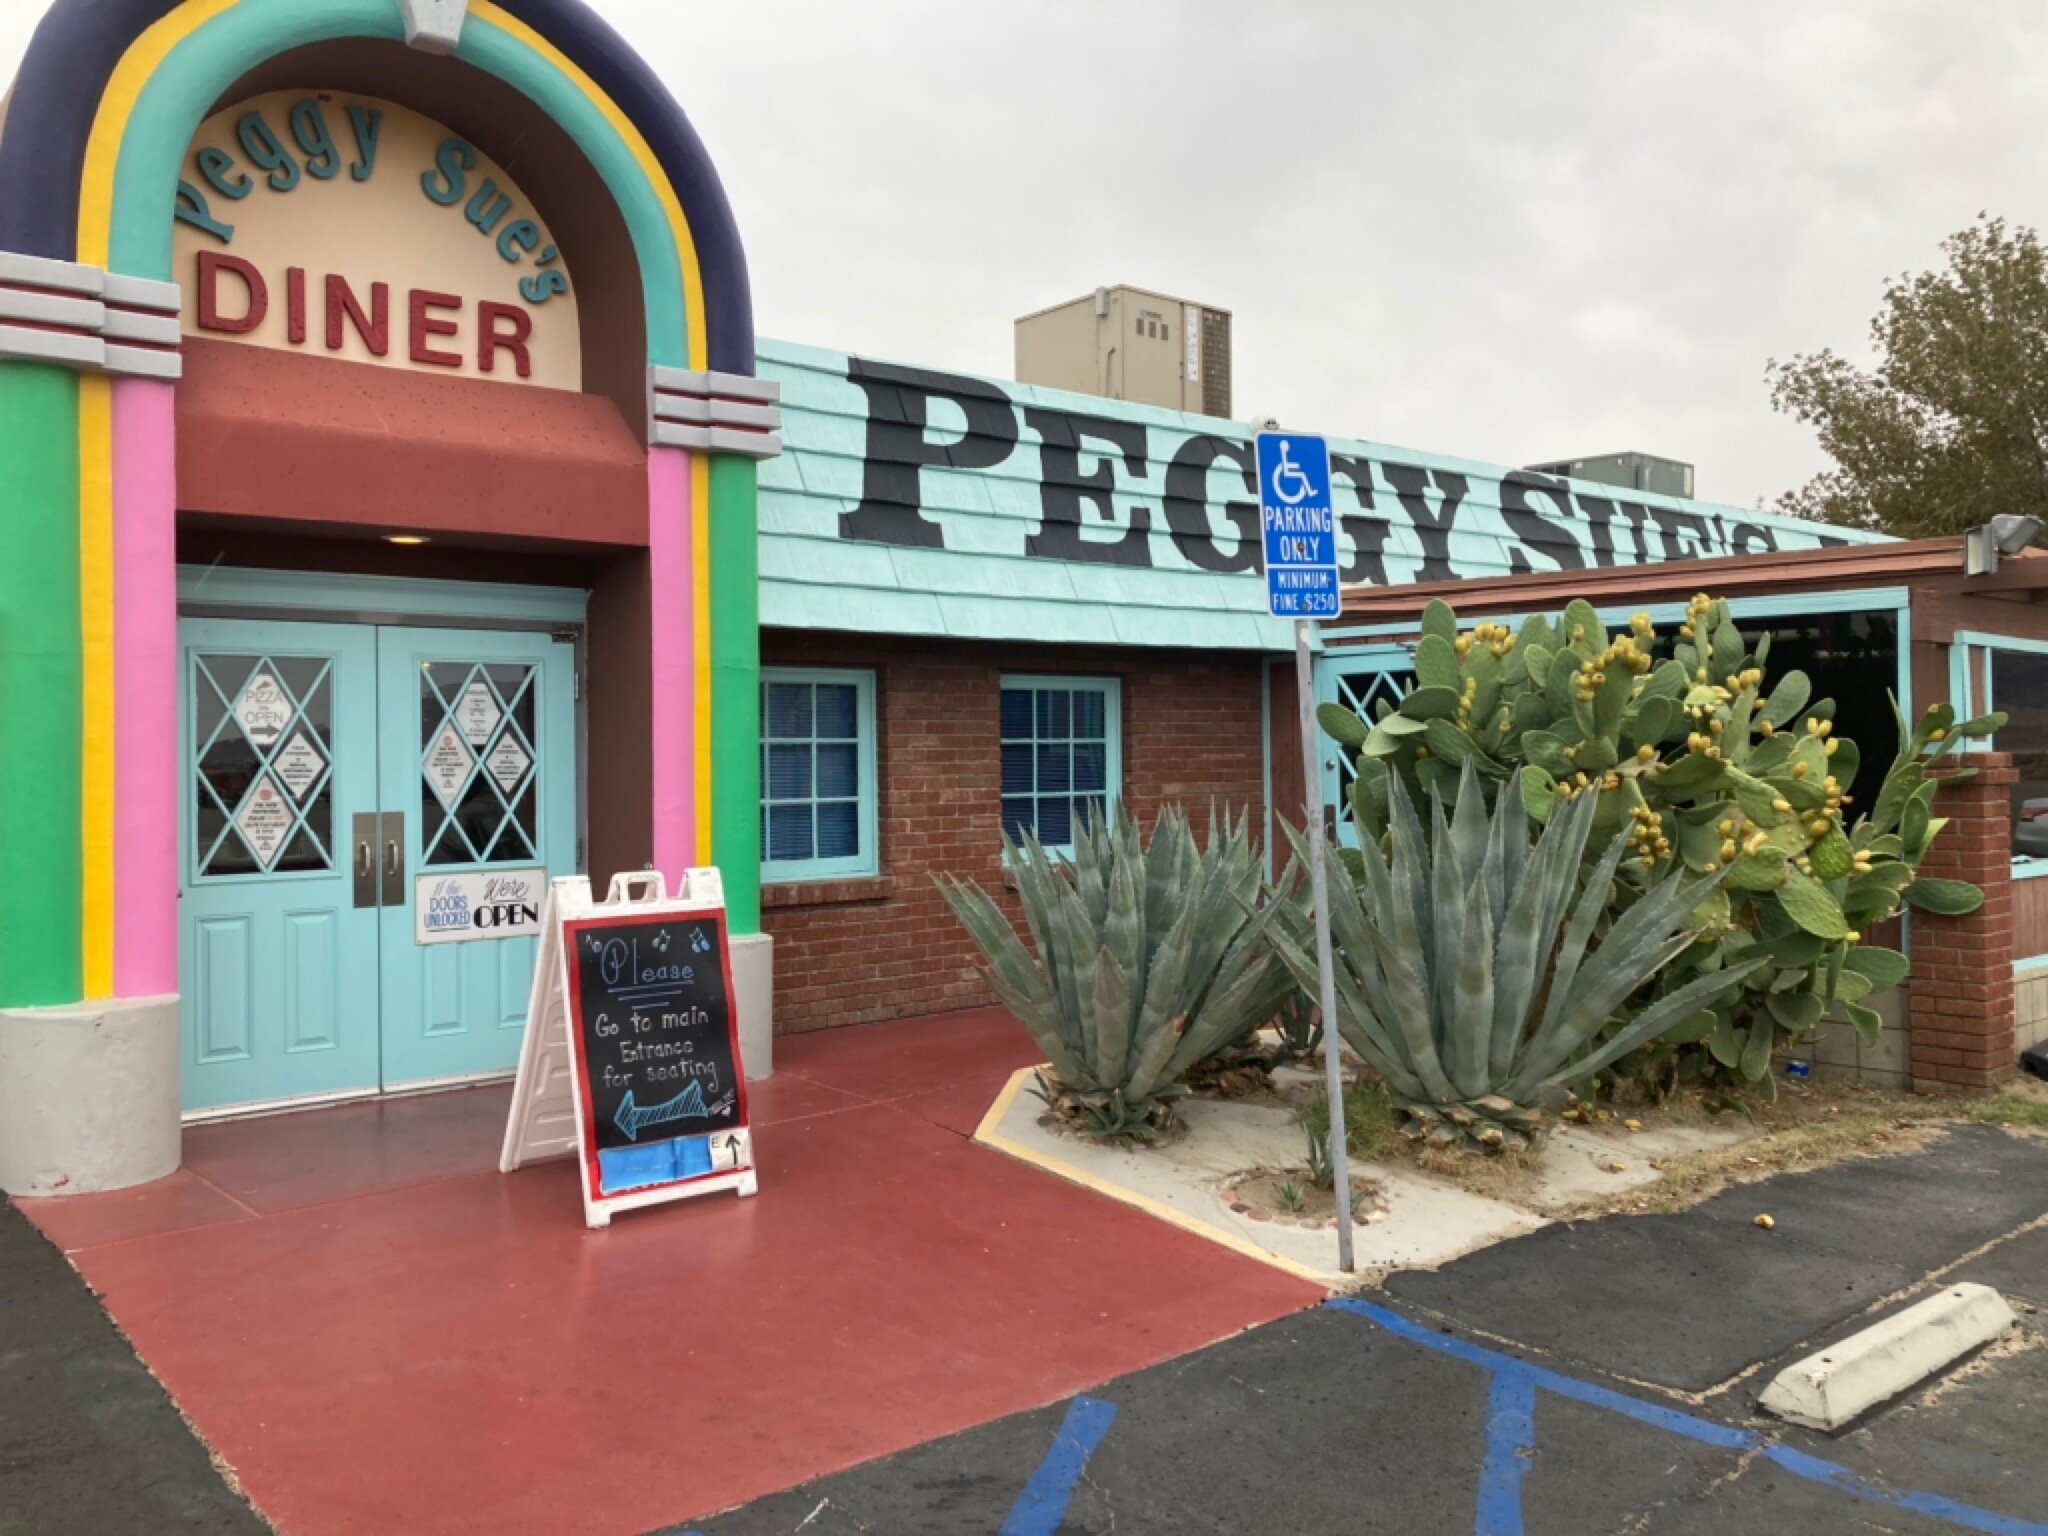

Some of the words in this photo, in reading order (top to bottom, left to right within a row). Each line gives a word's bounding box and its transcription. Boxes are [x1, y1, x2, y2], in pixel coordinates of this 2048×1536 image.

[420, 135, 568, 304] Sue's
[197, 248, 534, 380] DINER
[838, 356, 1470, 586] PEGGY
[1265, 505, 1331, 533] PARKING
[1280, 535, 1320, 562] ONLY
[1277, 571, 1329, 589] MINIMUM
[1273, 593, 1299, 611] FINE
[1303, 592, 1335, 613] $250
[245, 711, 284, 723] OPEN
[423, 910, 471, 929] UNLOCKED
[473, 901, 539, 929] OPEN
[601, 937, 695, 985] Please
[595, 1012, 620, 1037] Go
[629, 1011, 651, 1033] to
[661, 1005, 709, 1029] main
[619, 1040, 694, 1063] Entrance
[602, 1063, 633, 1089] for
[645, 1056, 719, 1093] seating
